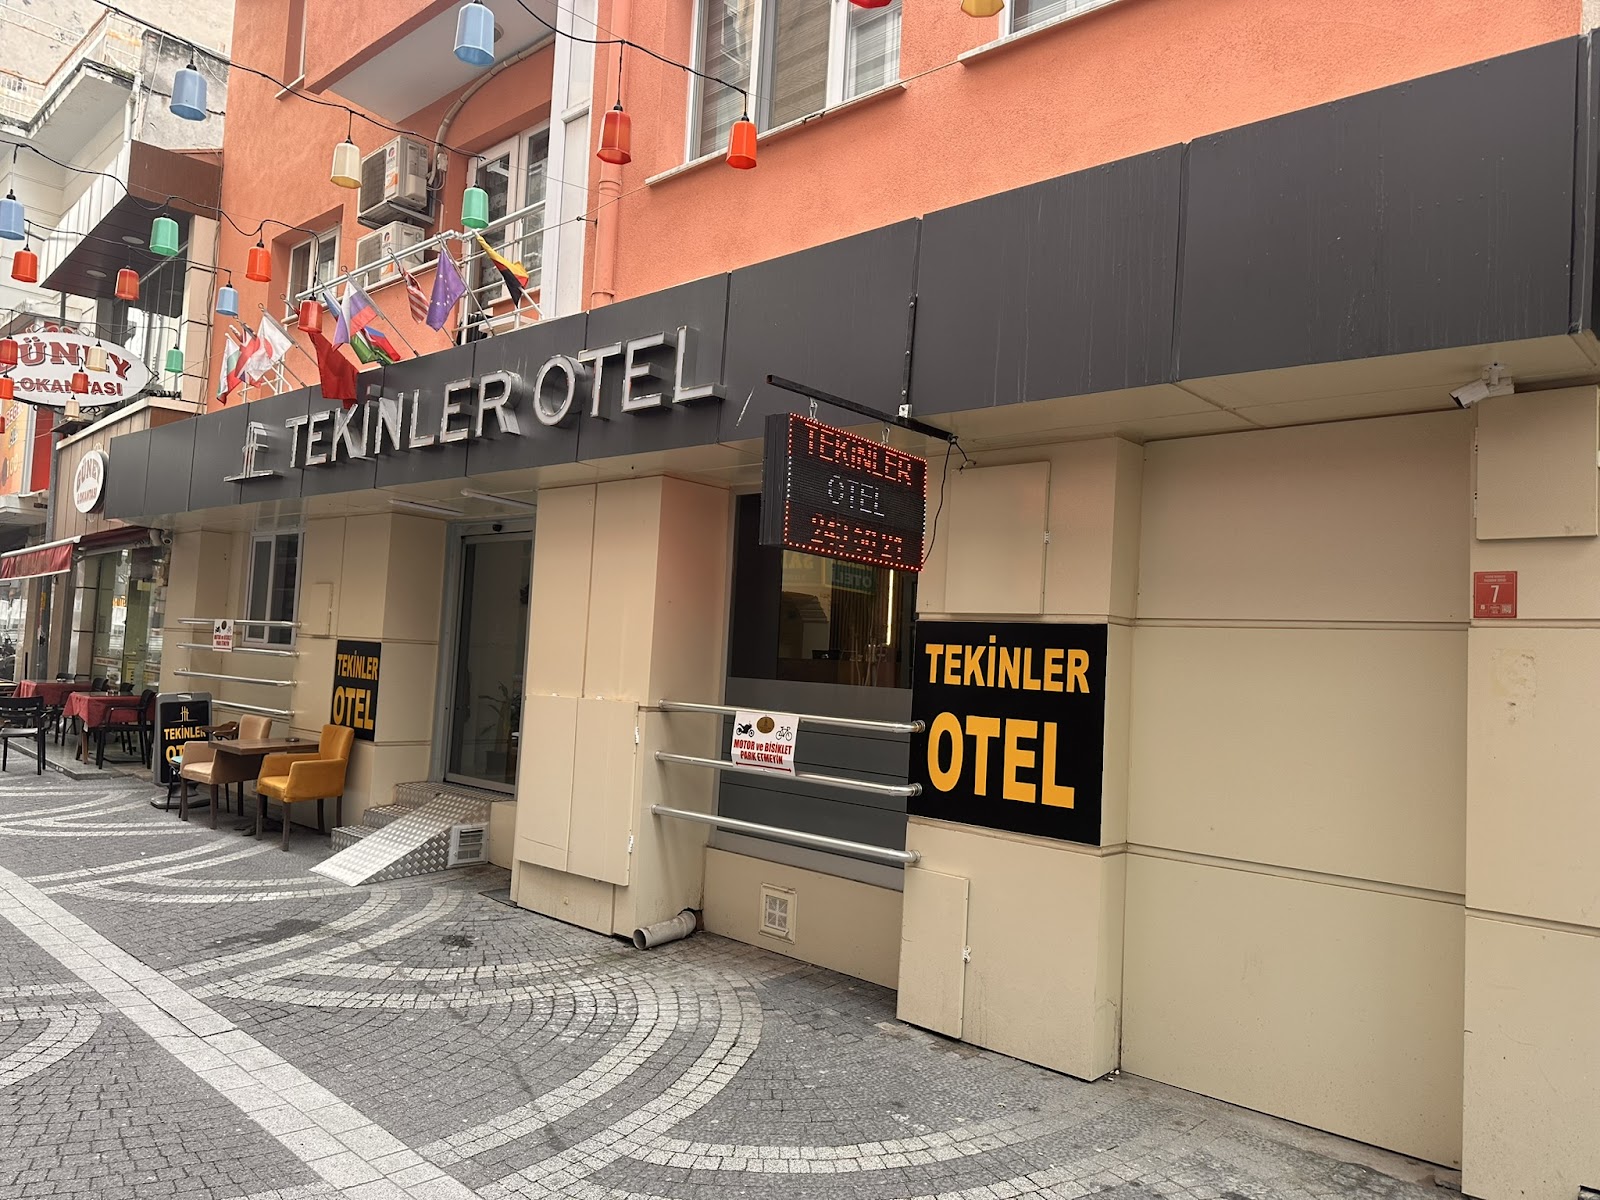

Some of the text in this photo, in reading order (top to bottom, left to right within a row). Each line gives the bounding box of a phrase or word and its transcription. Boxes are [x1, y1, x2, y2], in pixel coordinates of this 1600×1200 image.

[0, 336, 132, 380] ÜNY
[11, 376, 124, 397] OKAASI
[285, 325, 725, 468] TEKİNLER OTEL
[828, 475, 885, 517] OTEL
[1490, 584, 1500, 603] 7
[337, 649, 378, 681] TEKİNLER
[925, 634, 1090, 694] TEKİNLER
[333, 685, 374, 730] OTEL
[733, 738, 793, 756] MOTOR ve BİSİKLET
[740, 750, 784, 765] PARK ETMEYİN
[927, 711, 1075, 809] OTEL
